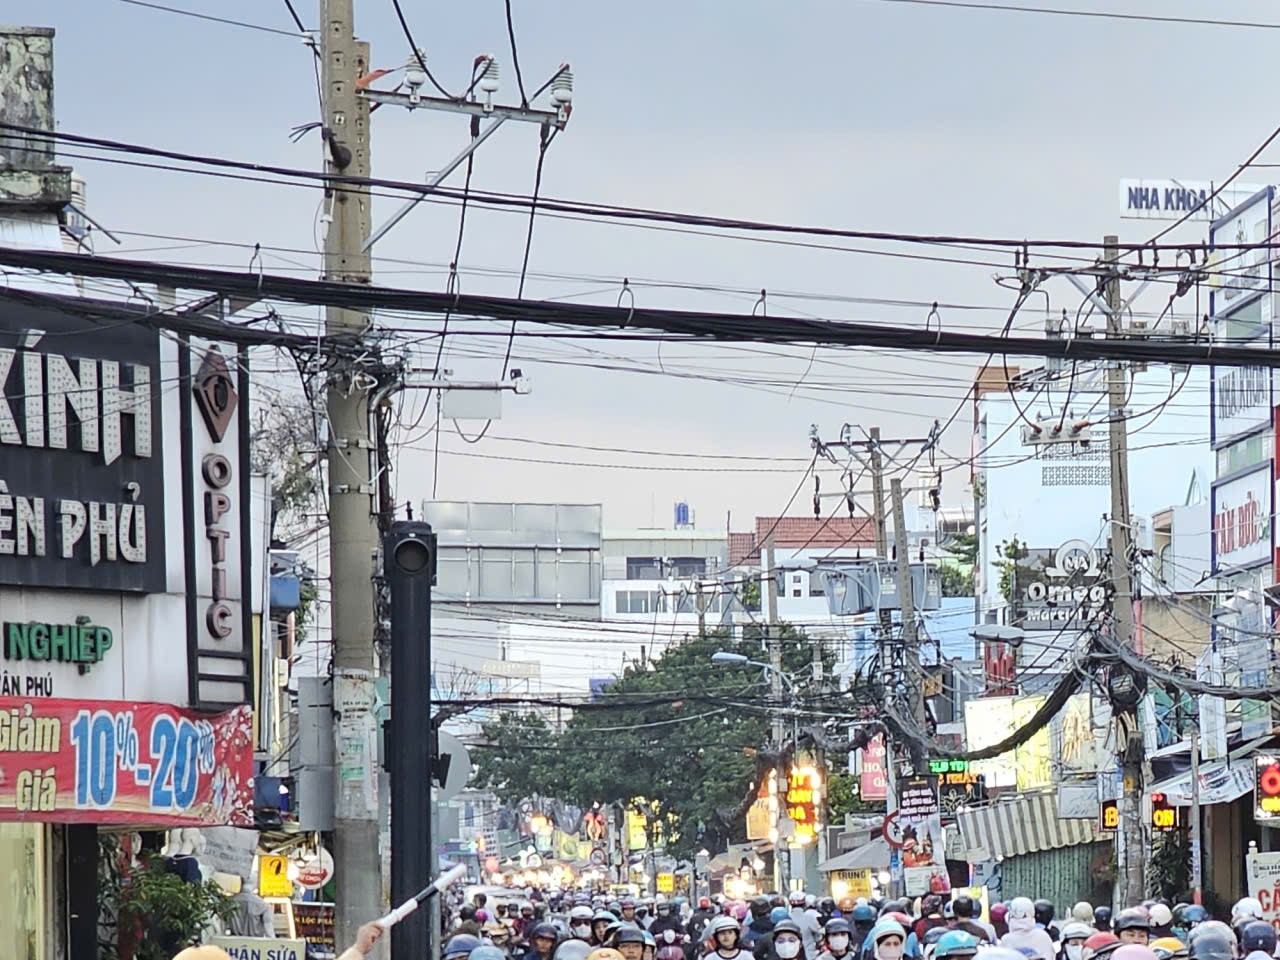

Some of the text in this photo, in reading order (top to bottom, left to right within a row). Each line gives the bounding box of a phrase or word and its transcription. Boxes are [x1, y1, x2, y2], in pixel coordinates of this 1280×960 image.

[1127, 186, 1208, 212] NHA KHOA
[60, 482, 147, 568] PHỦ
[202, 453, 233, 640] OPTIC
[3, 616, 113, 676] NGHIỆP
[26, 672, 53, 697] PHÚ
[0, 703, 62, 753] Giảm
[15, 767, 58, 812] Giá
